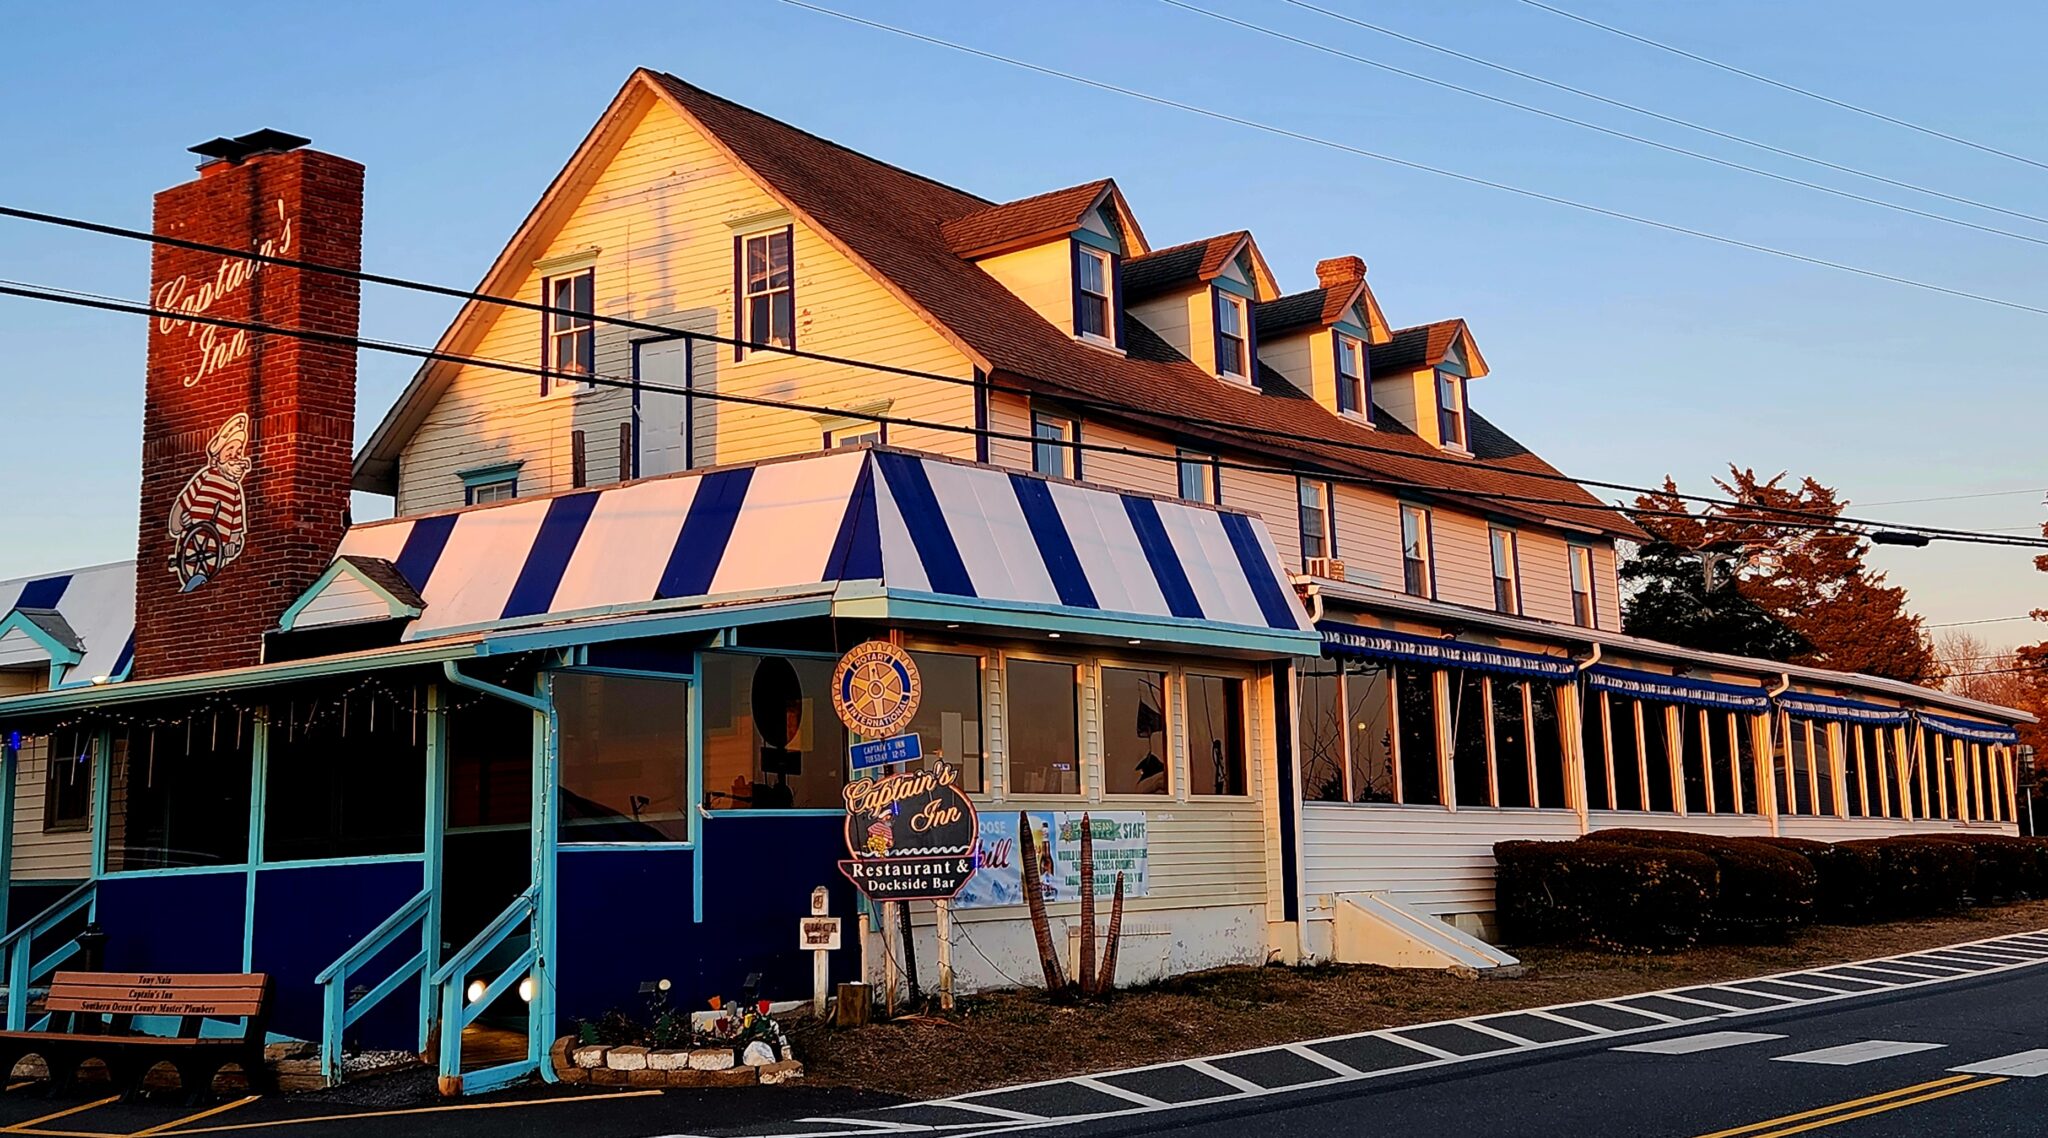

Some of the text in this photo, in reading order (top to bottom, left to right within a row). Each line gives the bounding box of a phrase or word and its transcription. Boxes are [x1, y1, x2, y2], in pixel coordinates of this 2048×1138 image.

[155, 197, 291, 338] Captain's
[182, 324, 249, 387] Inn
[854, 652, 891, 668] ROTARY
[846, 699, 910, 727] INTERNATIONAL
[846, 763, 957, 817] Captain's
[910, 798, 962, 832] Inn
[979, 821, 1006, 834] OOSE
[1123, 823, 1146, 840] STAFF
[976, 838, 1013, 869] hill
[852, 859, 970, 878] Restaurant &
[868, 877, 955, 891] Dockside Bar
[138, 975, 155, 986] Tony
[128, 989, 174, 1001] Captain's Inn
[80, 1000, 216, 1013] Southern Ocean County Master Plumbers
